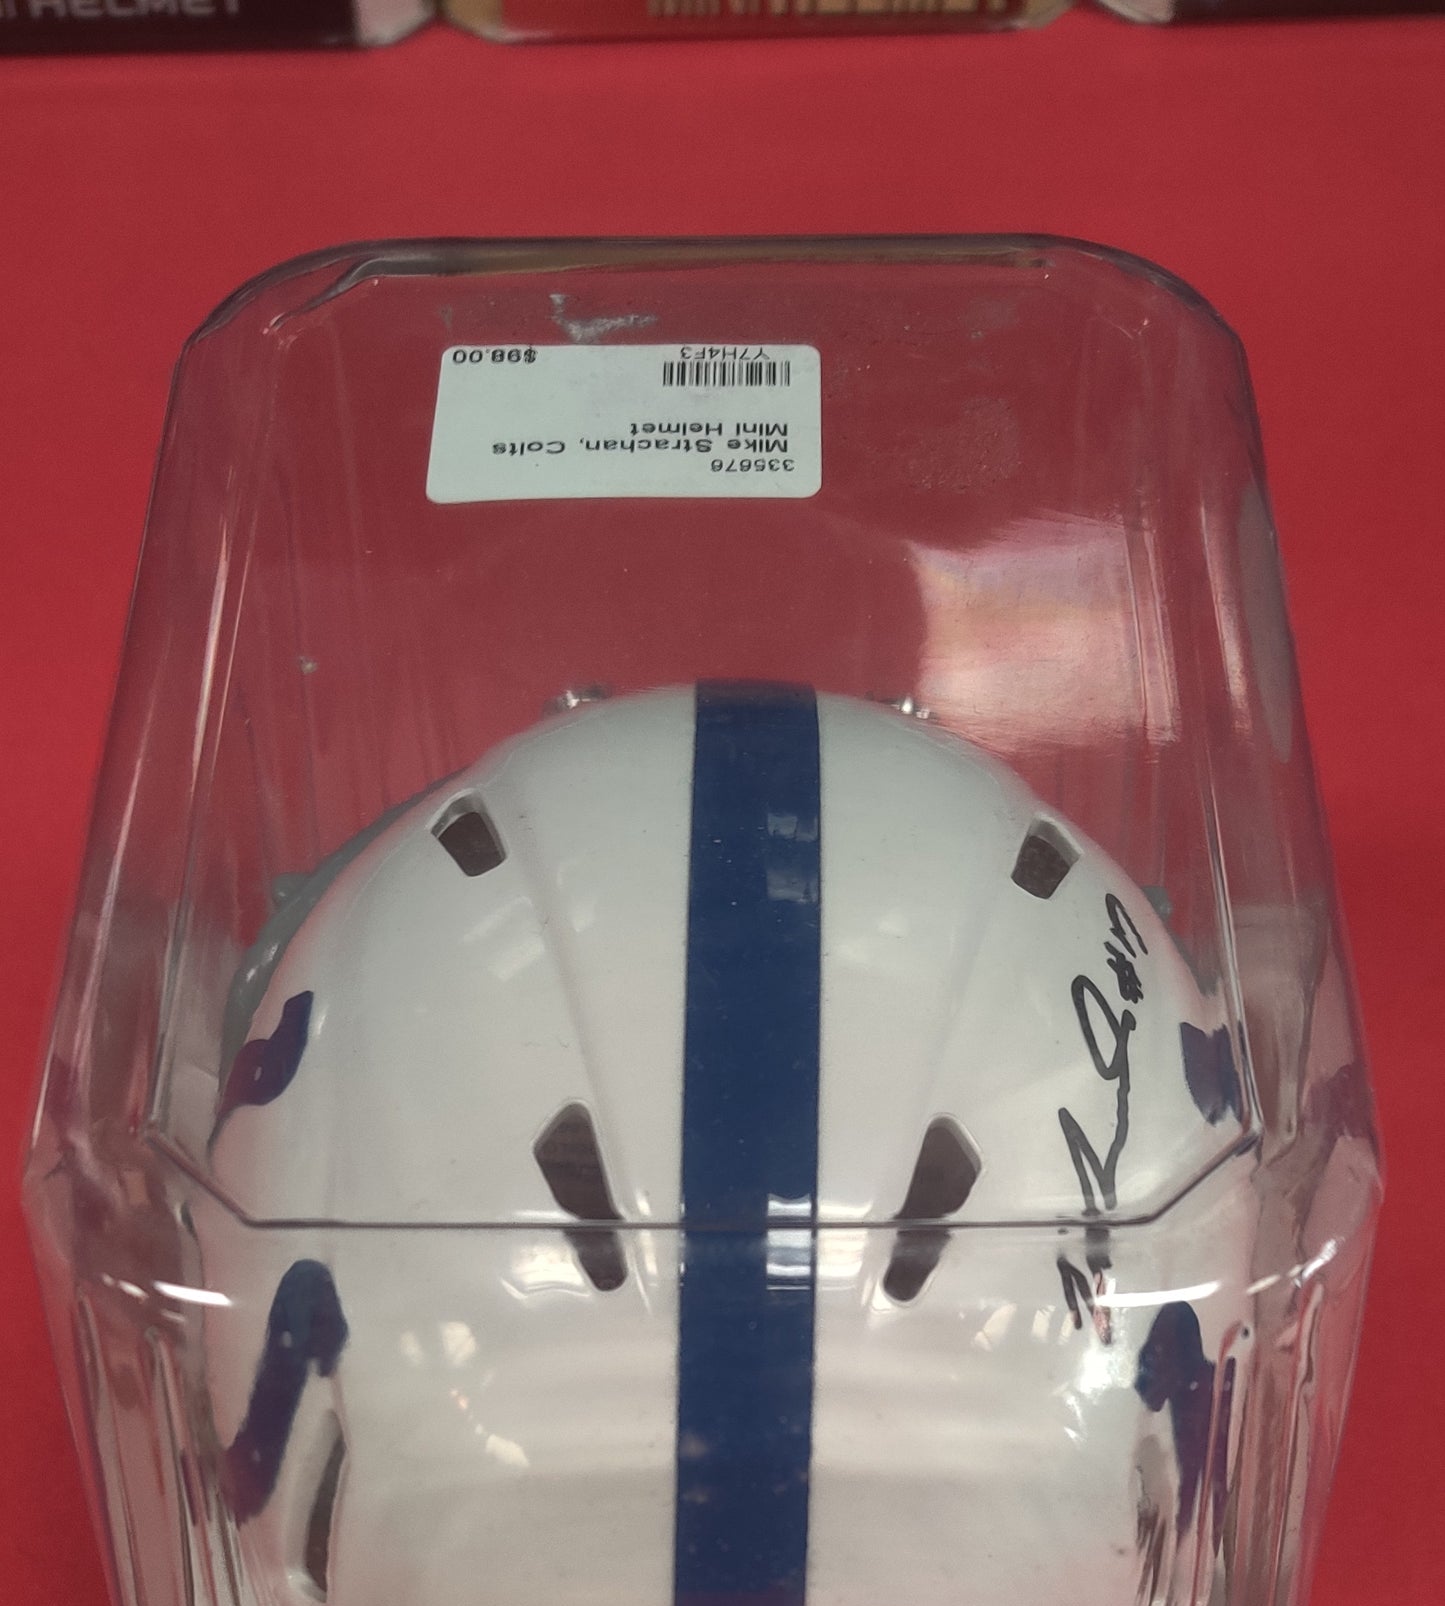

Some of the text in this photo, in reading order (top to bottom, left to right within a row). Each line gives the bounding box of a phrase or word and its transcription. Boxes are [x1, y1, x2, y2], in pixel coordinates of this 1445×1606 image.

[452, 346, 537, 364] $98.00
[679, 346, 770, 360] Y7H4F3
[630, 422, 788, 437] Mini Helmet
[492, 437, 788, 457] Mike Strachan, Colts
[710, 458, 795, 473] 335676
